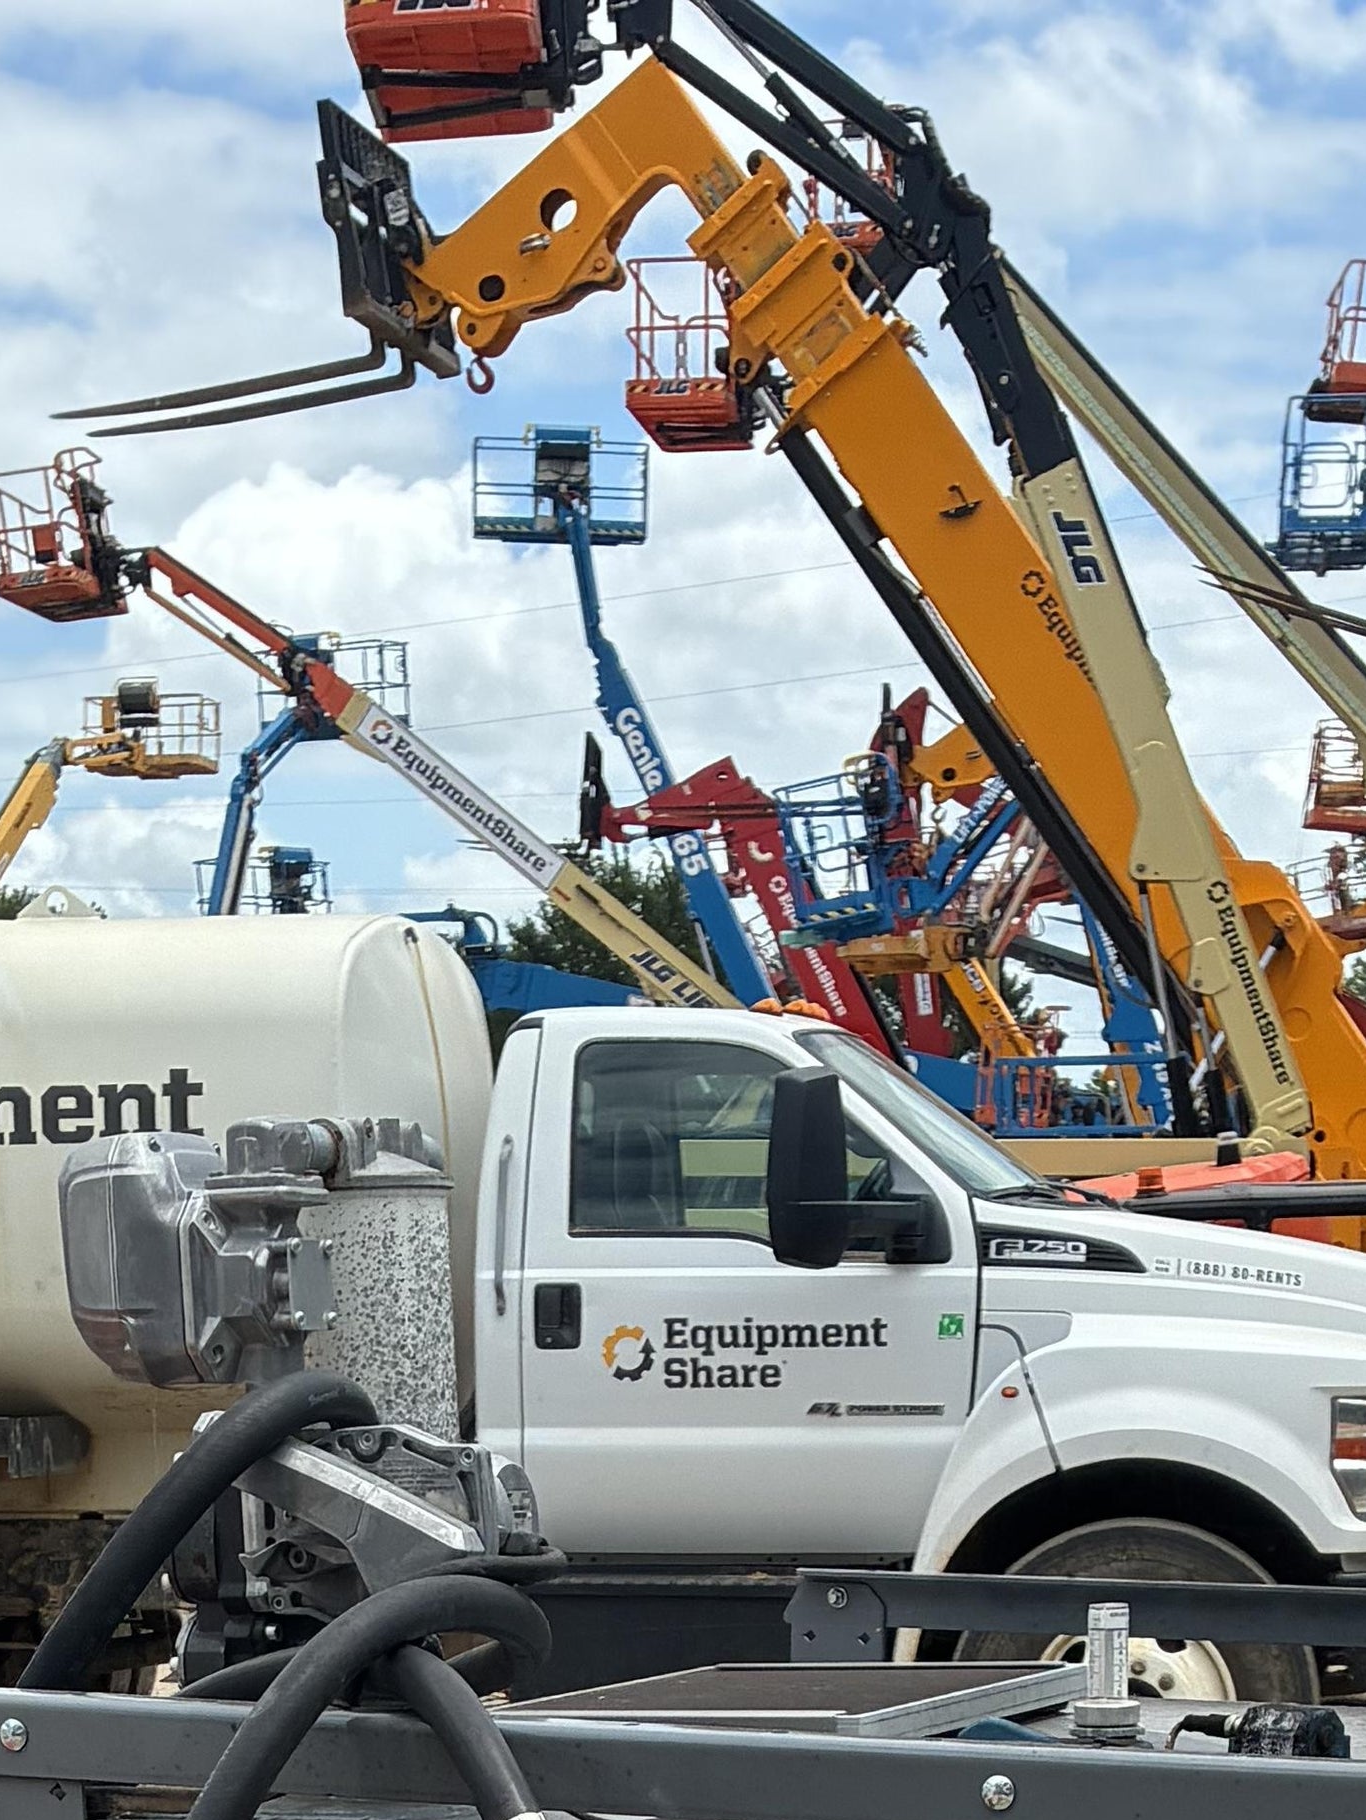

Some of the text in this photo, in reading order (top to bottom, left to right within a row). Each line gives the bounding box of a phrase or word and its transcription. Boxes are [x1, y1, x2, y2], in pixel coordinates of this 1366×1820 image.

[655, 379, 689, 395] JLG
[1053, 511, 1106, 583] JLG
[392, 735, 546, 873] EquipmentShare
[631, 950, 677, 984] JLG
[1218, 905, 1290, 1085] EquipmentShare
[1186, 1260, 1303, 1287] (888) 80-RENTS
[664, 1317, 888, 1356] Equipment
[664, 1358, 782, 1389] Share
